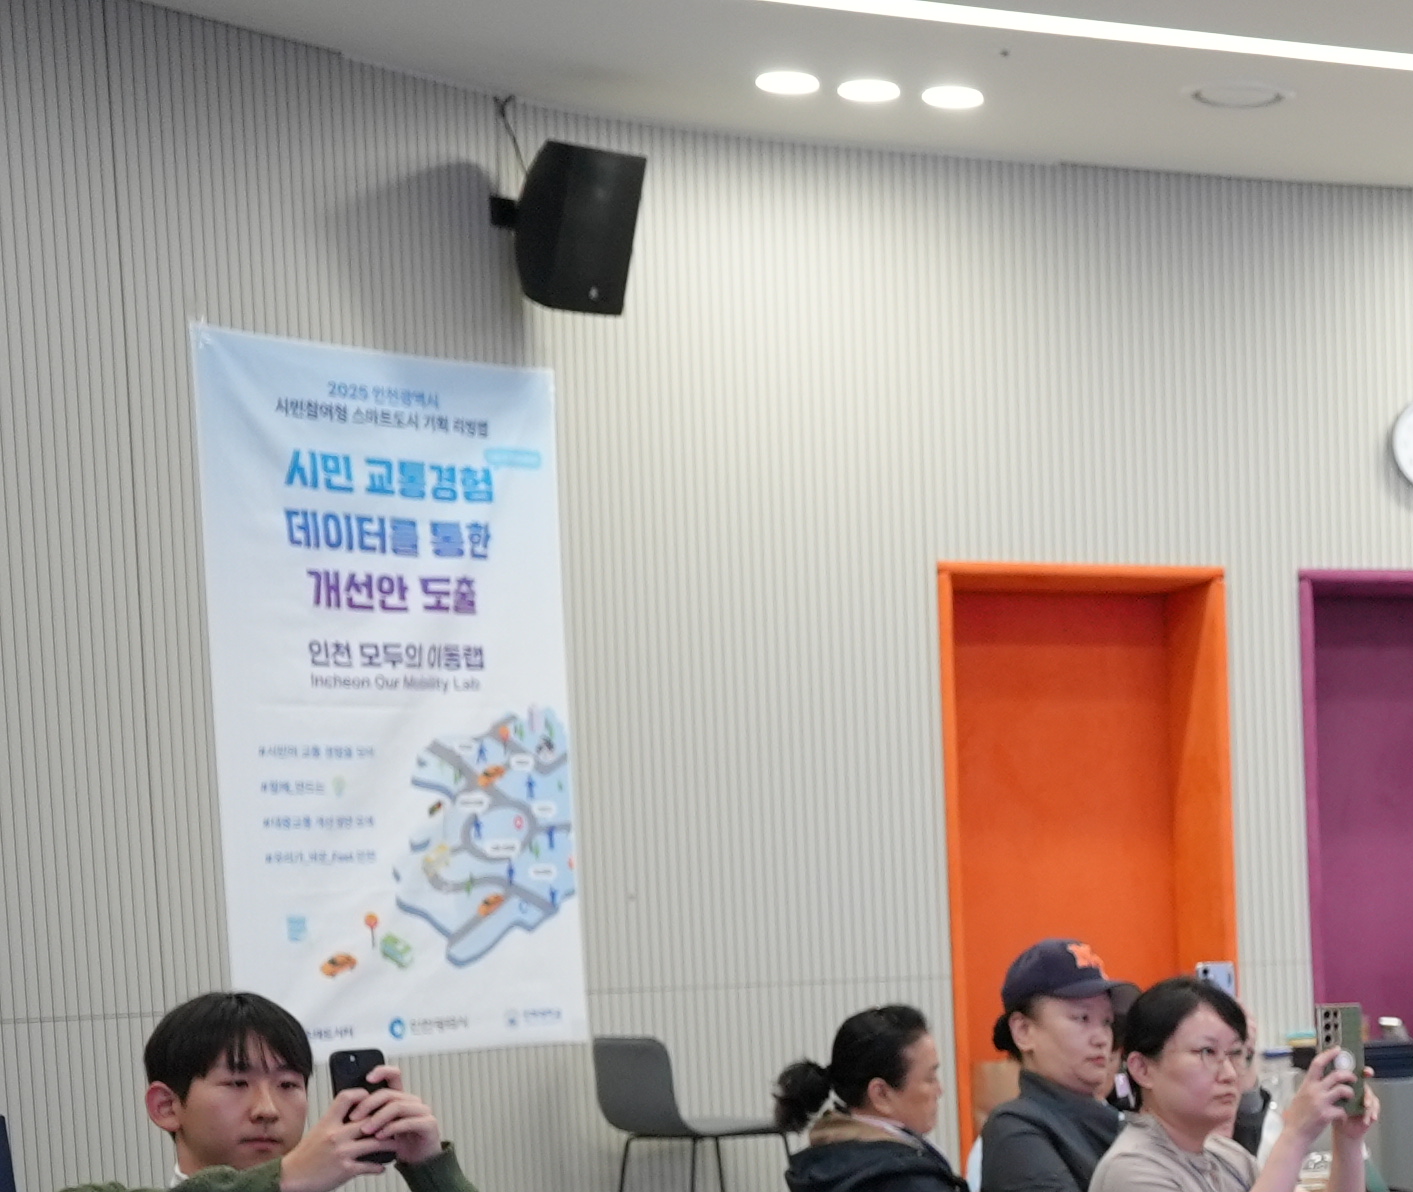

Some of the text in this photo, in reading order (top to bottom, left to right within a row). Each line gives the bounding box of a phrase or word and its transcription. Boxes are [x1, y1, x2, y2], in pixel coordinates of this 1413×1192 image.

[327, 381, 369, 399] 2025
[275, 397, 348, 424] 시민참여형
[352, 406, 419, 430] 스마트도시
[422, 414, 450, 433] 기획
[284, 448, 494, 503] 시민 교통경험
[284, 507, 491, 560] 데이터를 통한
[306, 568, 478, 615] 개선안 도출
[308, 639, 485, 671] 인천 모두의 이동랩
[310, 674, 482, 694] Incheon Our Mobility Lab
